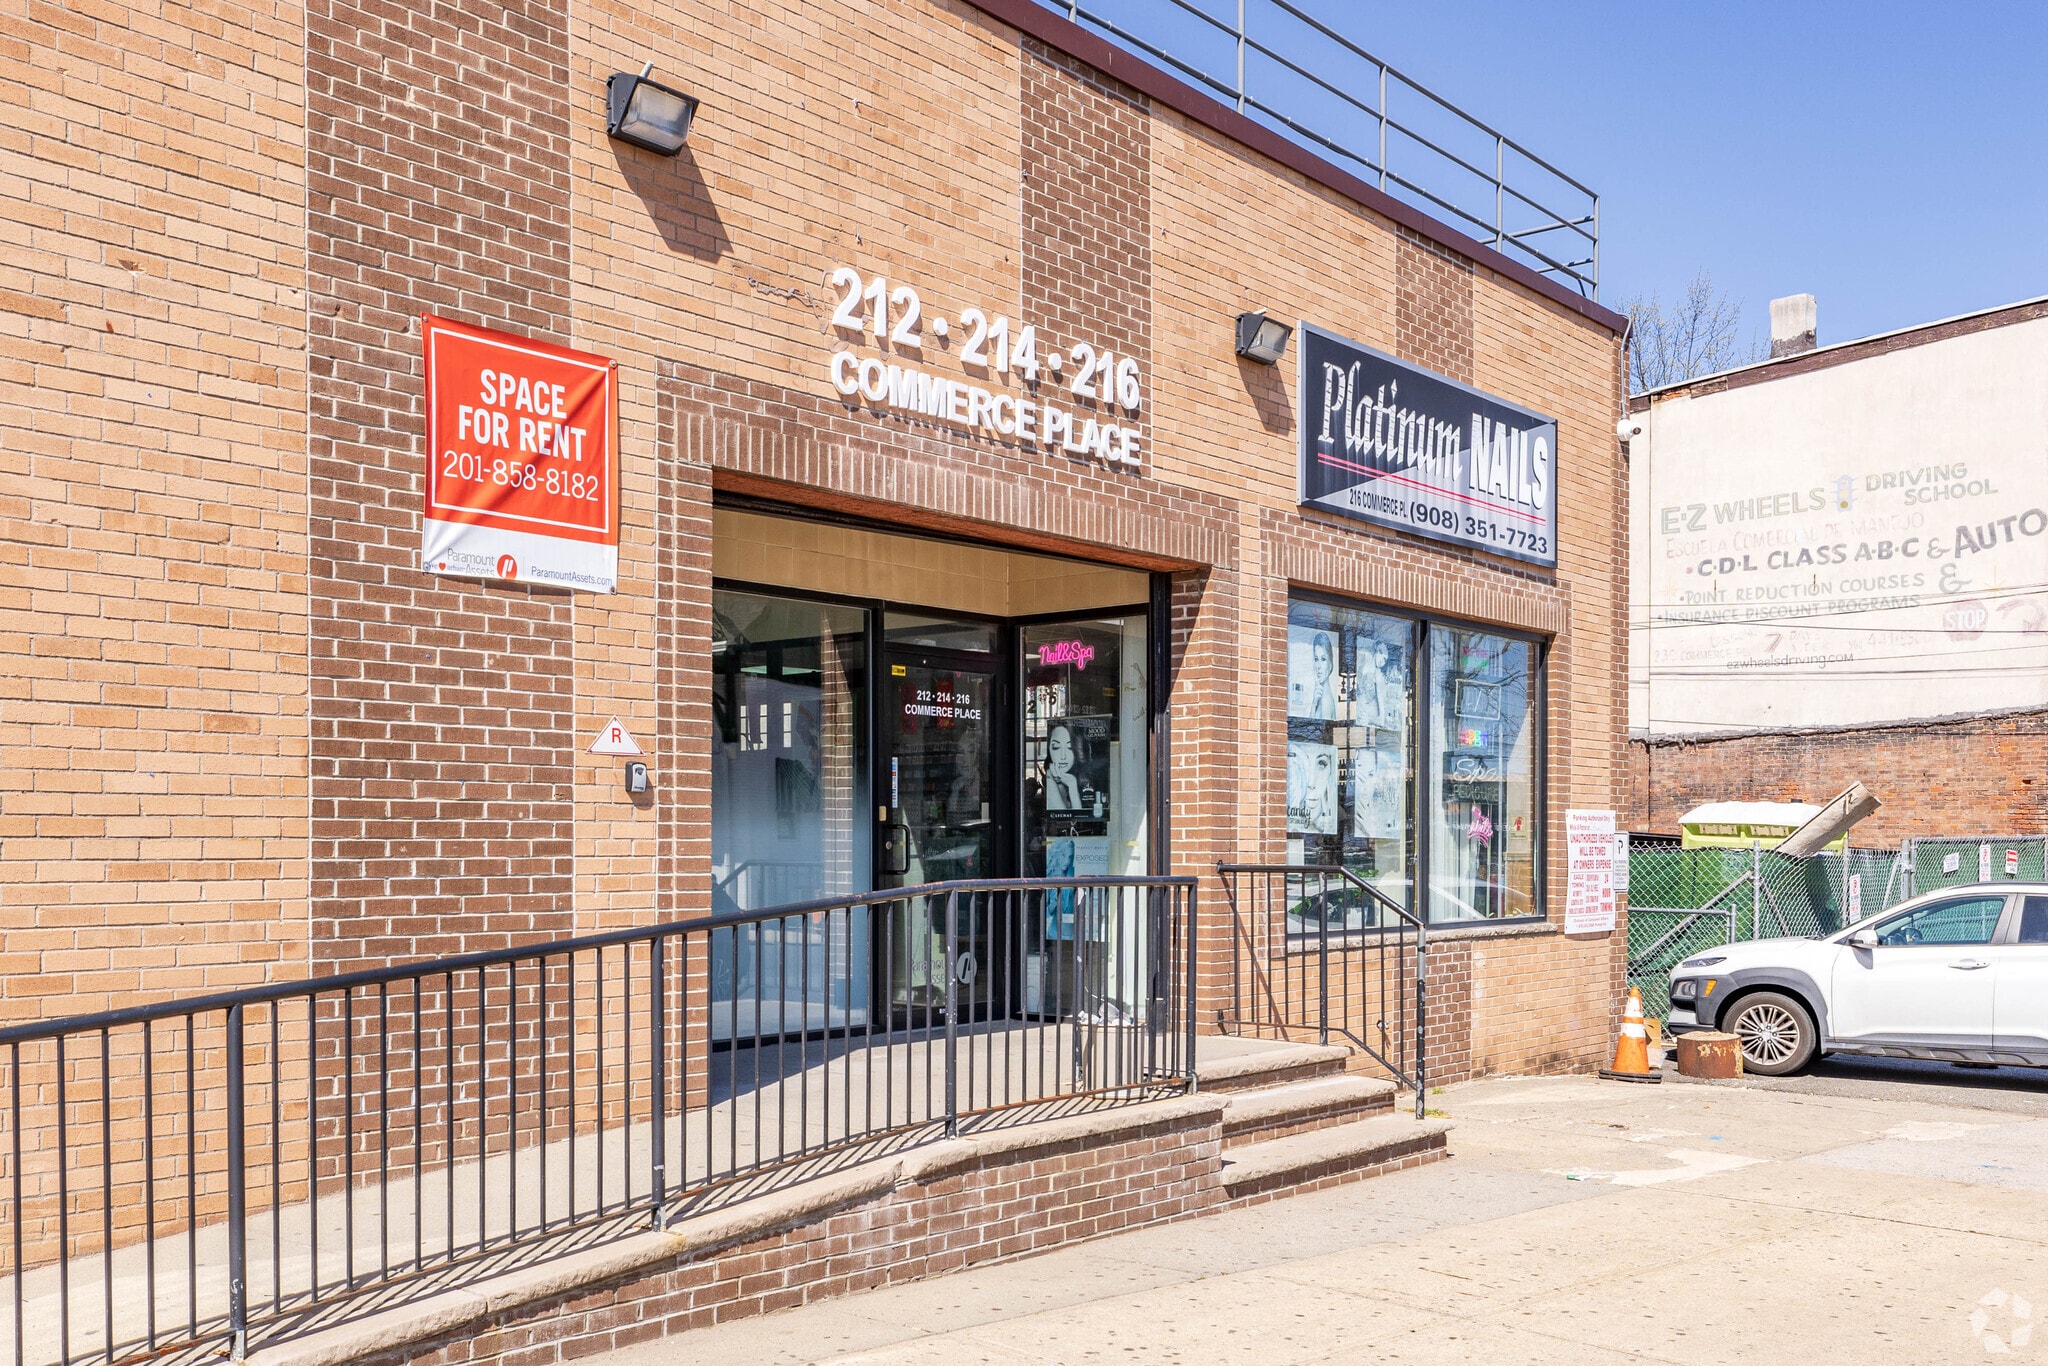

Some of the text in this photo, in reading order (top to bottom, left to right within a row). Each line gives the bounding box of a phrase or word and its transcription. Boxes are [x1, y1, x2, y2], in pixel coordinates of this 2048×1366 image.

[831, 267, 1140, 410] 212 214 216
[480, 368, 567, 420] SPACE
[830, 351, 1141, 467] COMMERCE PLACE
[458, 404, 587, 462] FOR RENT
[1317, 360, 1463, 482] Platinum
[443, 450, 599, 502] 201-858-8182
[1469, 412, 1548, 510] NAILS
[1865, 462, 1968, 492] DRIVING
[1904, 478, 1999, 506] SCHOOL
[1350, 488, 1362, 507] 216
[1362, 491, 1399, 517] COMMERCE
[1713, 487, 1826, 525] WHEELS
[1409, 500, 1548, 554] (908) 351-7723
[1767, 543, 1848, 571] CLASS
[1927, 537, 1952, 560] &
[1954, 507, 2048, 559] AUTO
[447, 547, 495, 567] Paramount
[1665, 537, 1727, 559] ESCUELA
[465, 563, 495, 577] Assets
[531, 566, 613, 586] ParamountAssets.com
[1685, 572, 1925, 605] POINT REDUCTION COURSES
[1664, 594, 1921, 626] INSURANCE DISCOUNT PROGRAMS
[1945, 606, 1985, 630] STOP
[905, 704, 981, 719] COMMERCE PLACE
[917, 690, 970, 704] 212 214 216
[611, 727, 621, 743] R
[1453, 758, 1501, 784] Spa
